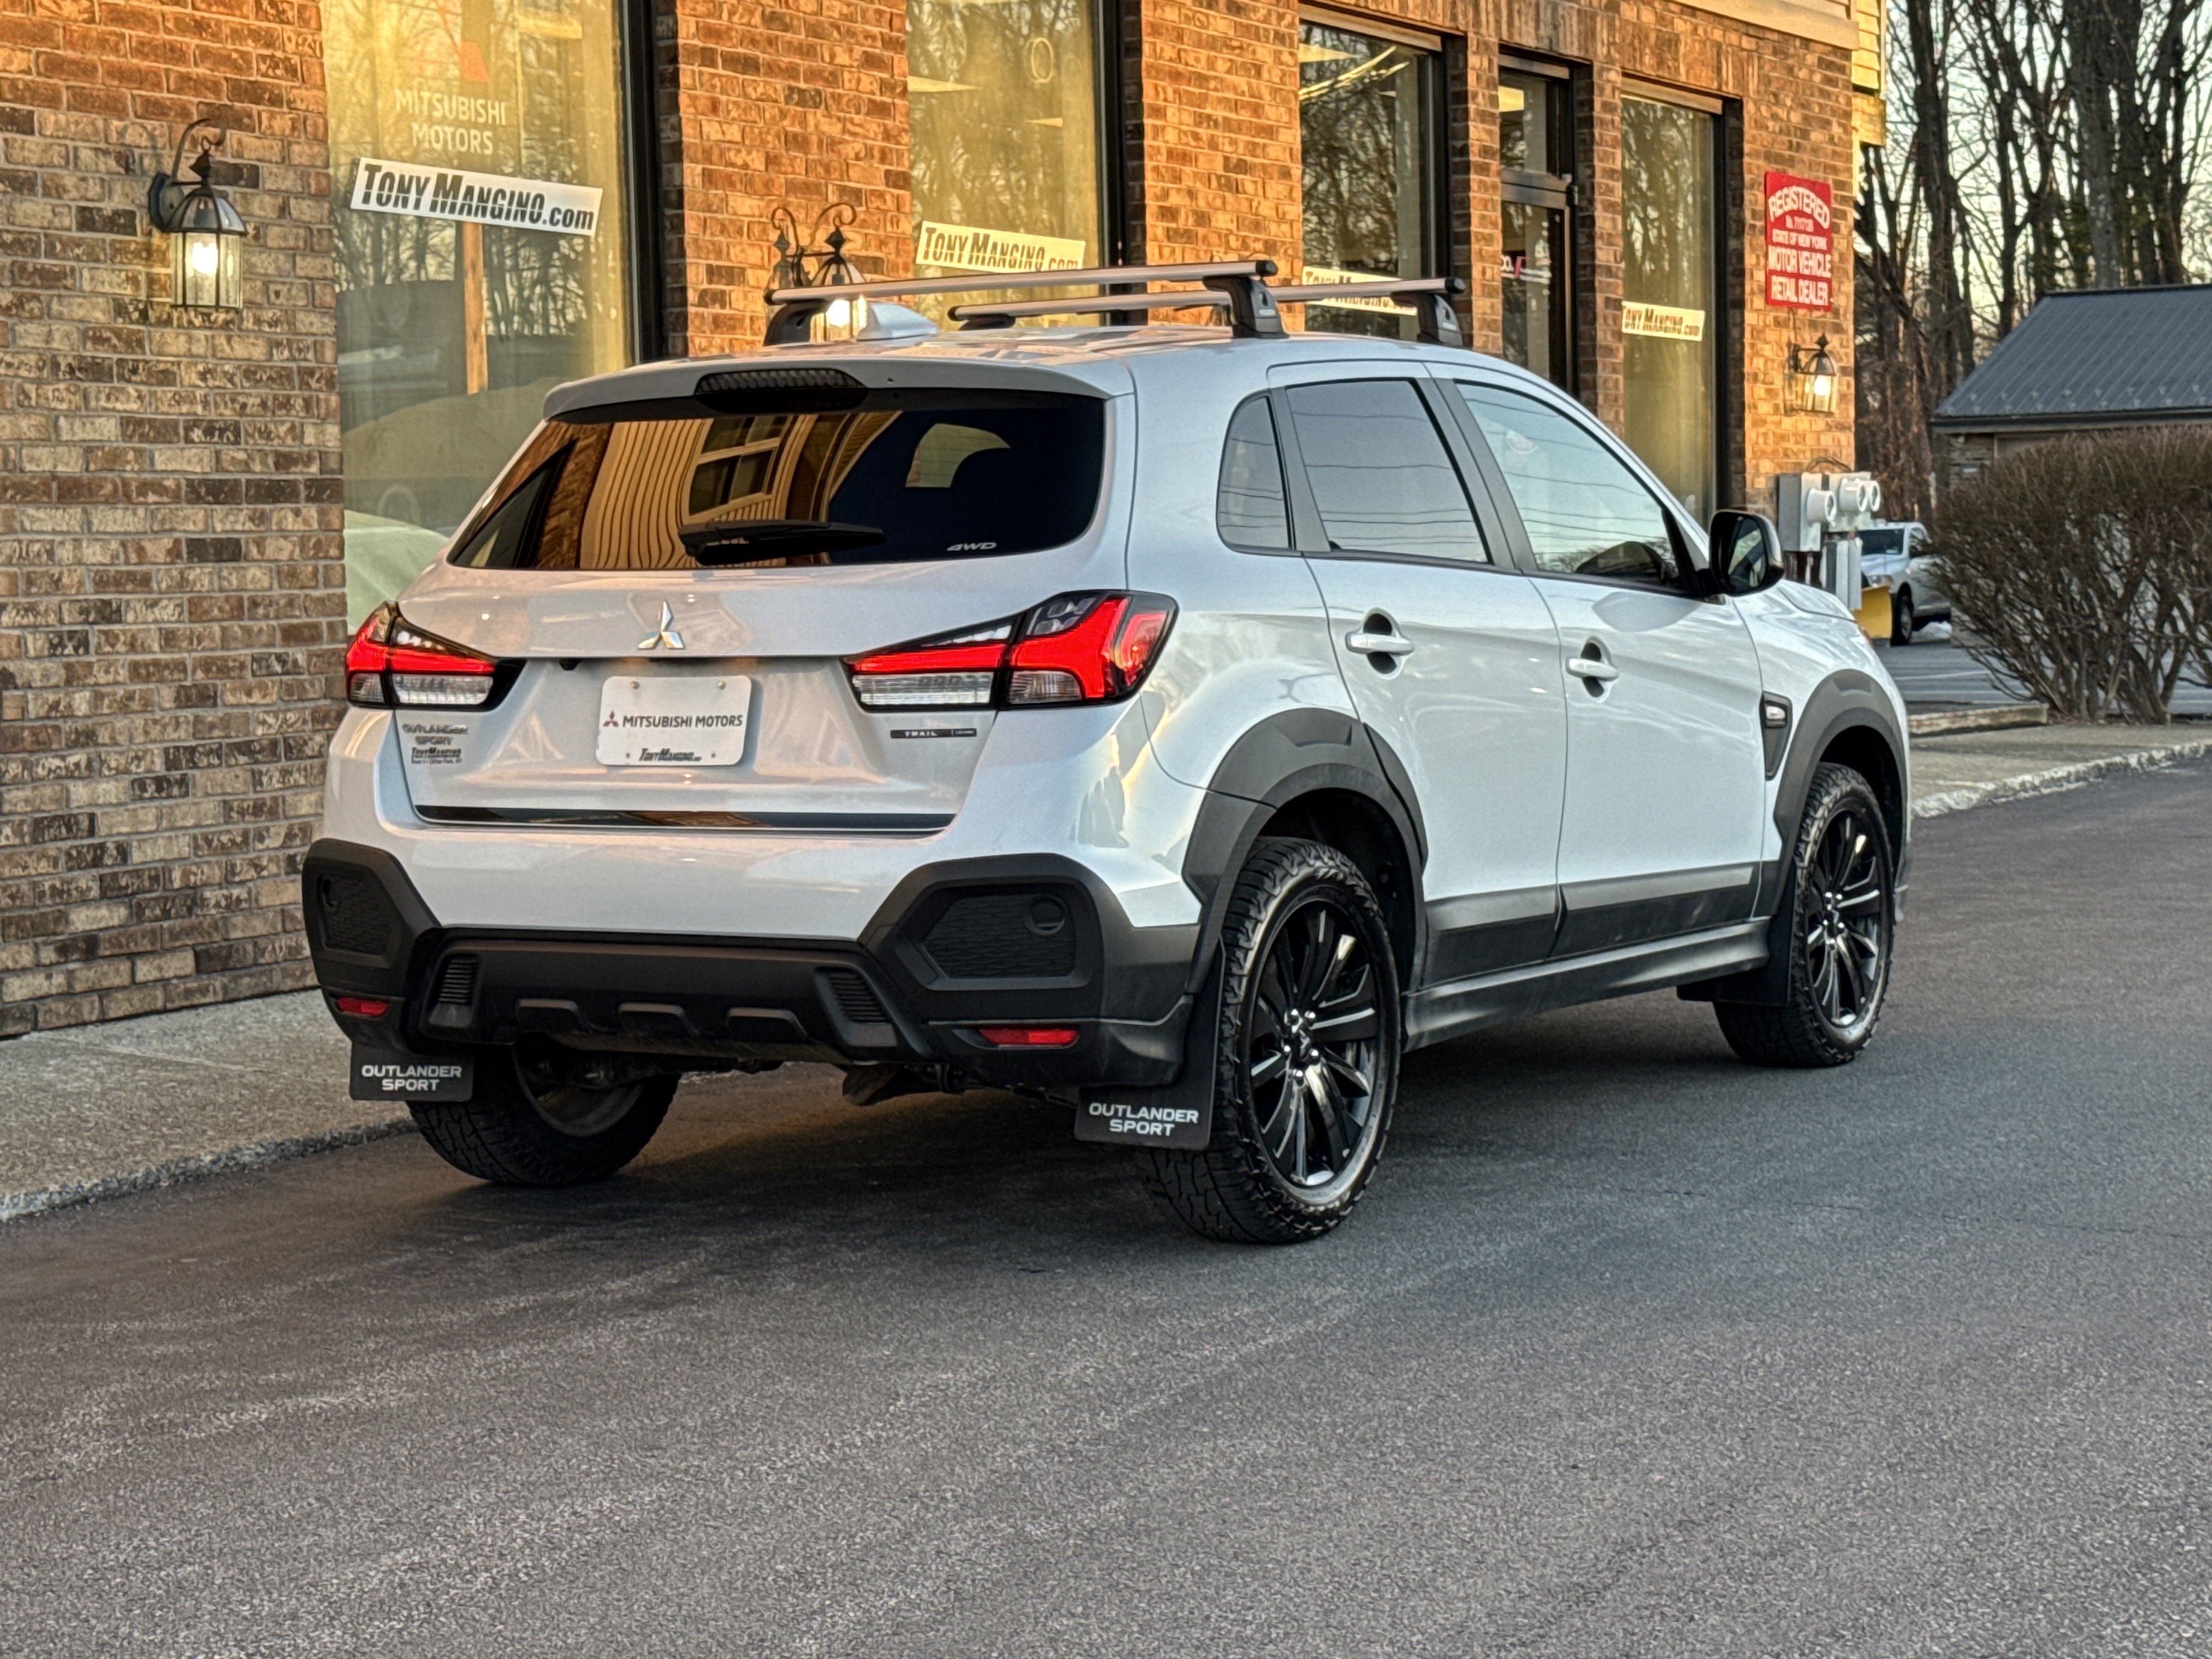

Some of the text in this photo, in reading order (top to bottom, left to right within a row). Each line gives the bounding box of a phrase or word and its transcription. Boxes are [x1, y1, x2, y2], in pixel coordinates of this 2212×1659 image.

[394, 88, 506, 126] MITSUBISHI
[411, 122, 494, 155] MOTORS
[1768, 185, 1830, 229] REGISTERED
[1768, 245, 1832, 278] MOTOR VEHICLE
[1771, 275, 1829, 306] RETAIL DEALER
[946, 542, 997, 551] 4WD
[622, 714, 743, 728] MITSUBISHI MOTORS
[361, 1064, 462, 1078] OUTLANDER
[382, 1079, 441, 1091] SPORT
[1088, 1102, 1199, 1124] OUTLANDER
[1109, 1119, 1175, 1137] SPORT
